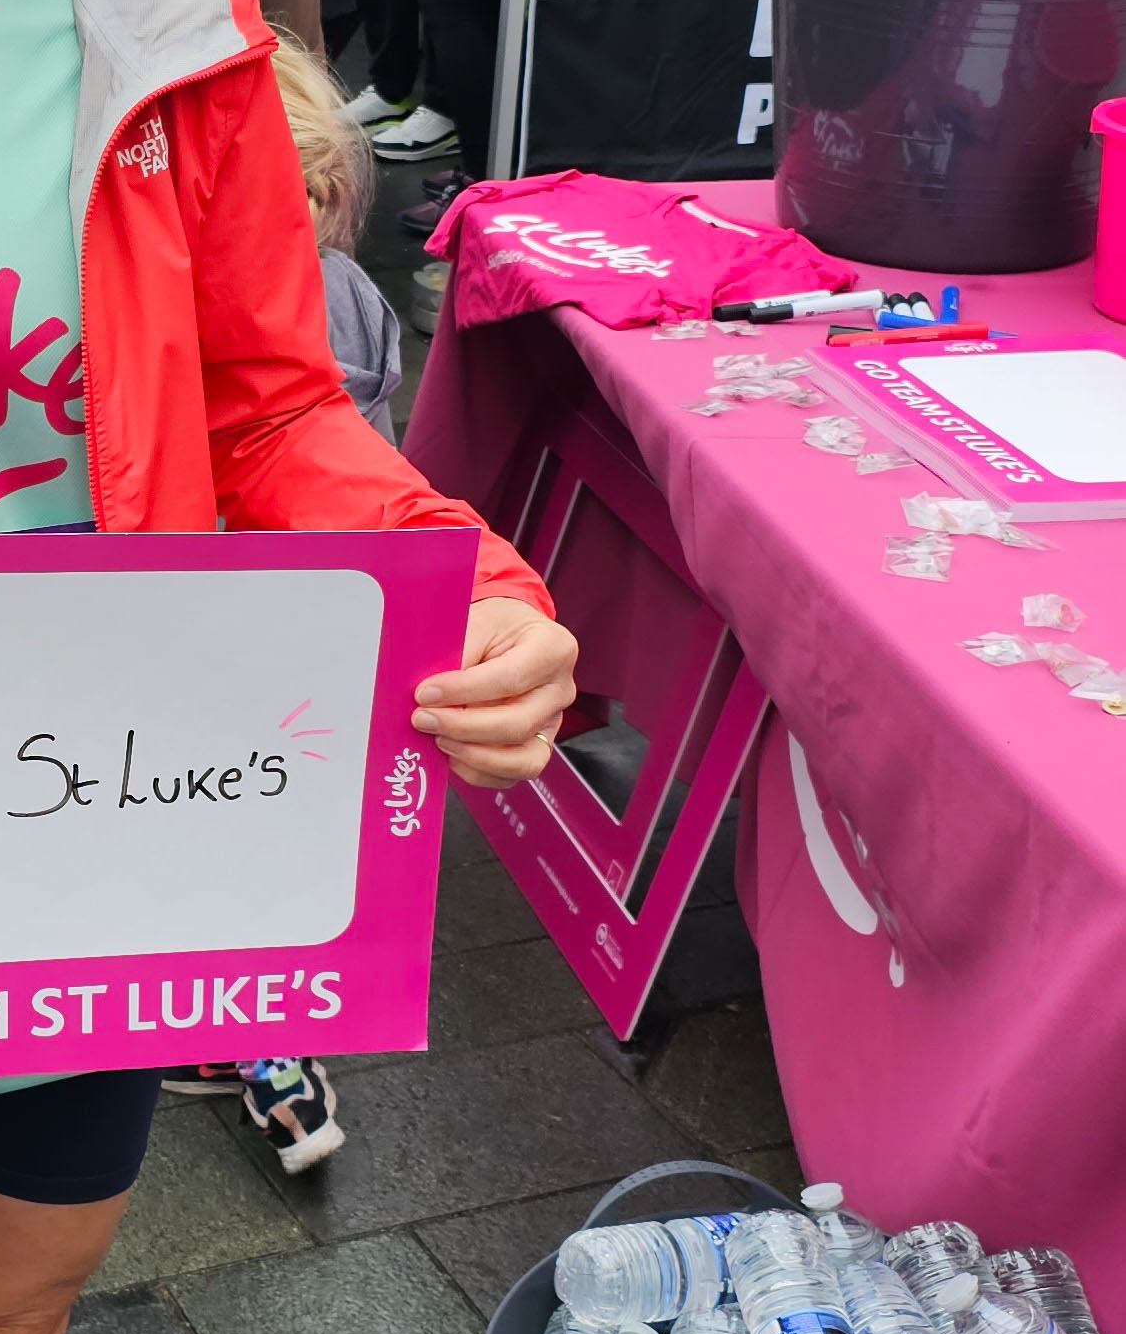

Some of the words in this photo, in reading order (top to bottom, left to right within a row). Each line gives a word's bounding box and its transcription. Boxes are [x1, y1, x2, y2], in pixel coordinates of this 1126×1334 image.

[116, 132, 169, 168] NORT
[139, 114, 164, 140] TH
[853, 359, 900, 381] GO
[882, 379, 952, 417] TEAM
[929, 417, 979, 442] ST
[954, 434, 1045, 484] LUKE'S
[6, 732, 100, 819] St
[118, 729, 289, 805] Luke's
[384, 747, 421, 807] Luke's
[389, 809, 421, 837] St
[29, 984, 108, 1039] ST
[127, 970, 344, 1034] LUKE'S
